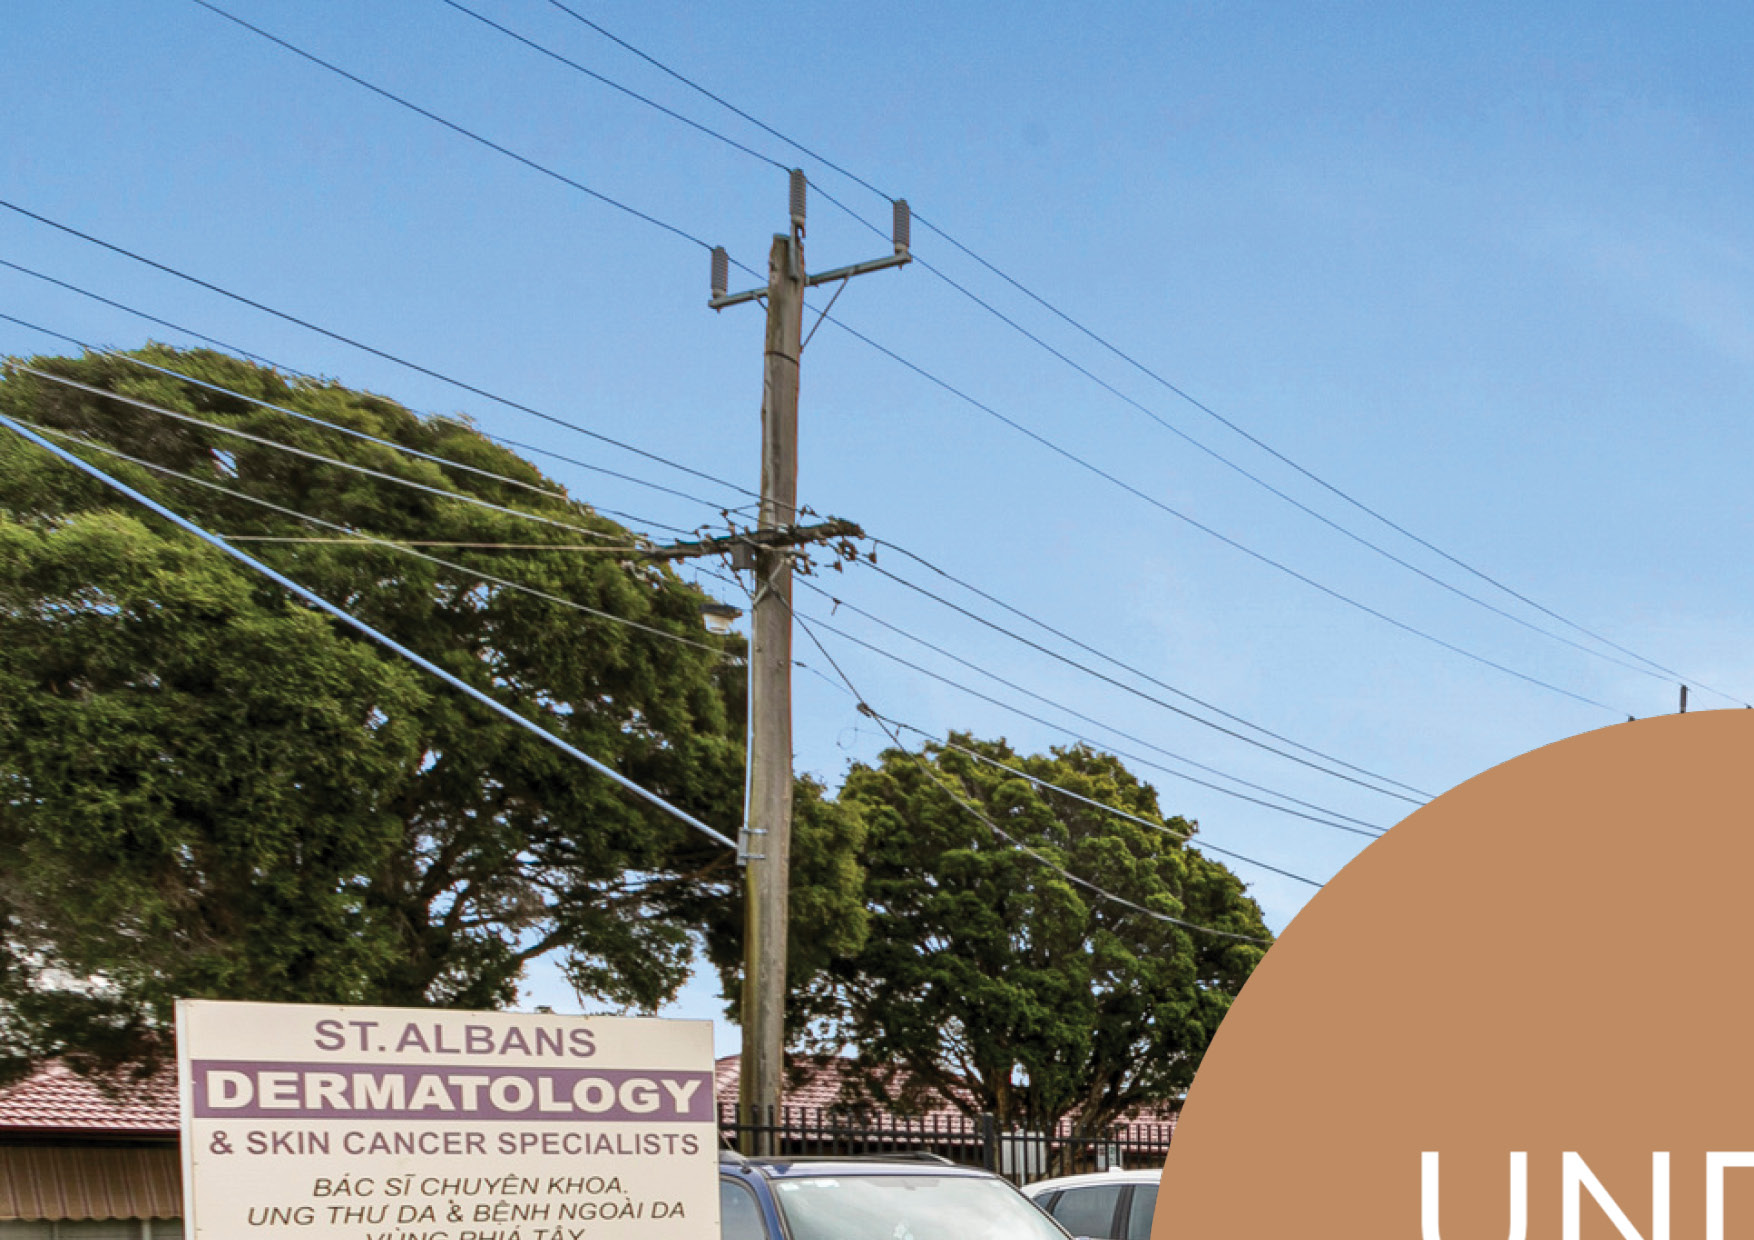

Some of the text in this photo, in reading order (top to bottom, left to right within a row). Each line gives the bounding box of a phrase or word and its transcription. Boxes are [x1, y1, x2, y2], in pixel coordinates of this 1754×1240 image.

[206, 1070, 702, 1113] DERMATOLOGY
[209, 1130, 700, 1156] & SKIN CANCER SPECIALISTS
[313, 1172, 375, 1197] BÁC
[420, 1173, 540, 1197] CHUYÊN
[547, 1175, 629, 1195] KHOA.
[248, 1206, 315, 1226] UNG
[397, 1204, 437, 1224] DA
[558, 1196, 644, 1221] NGOÀI
[650, 1201, 686, 1219] DA
